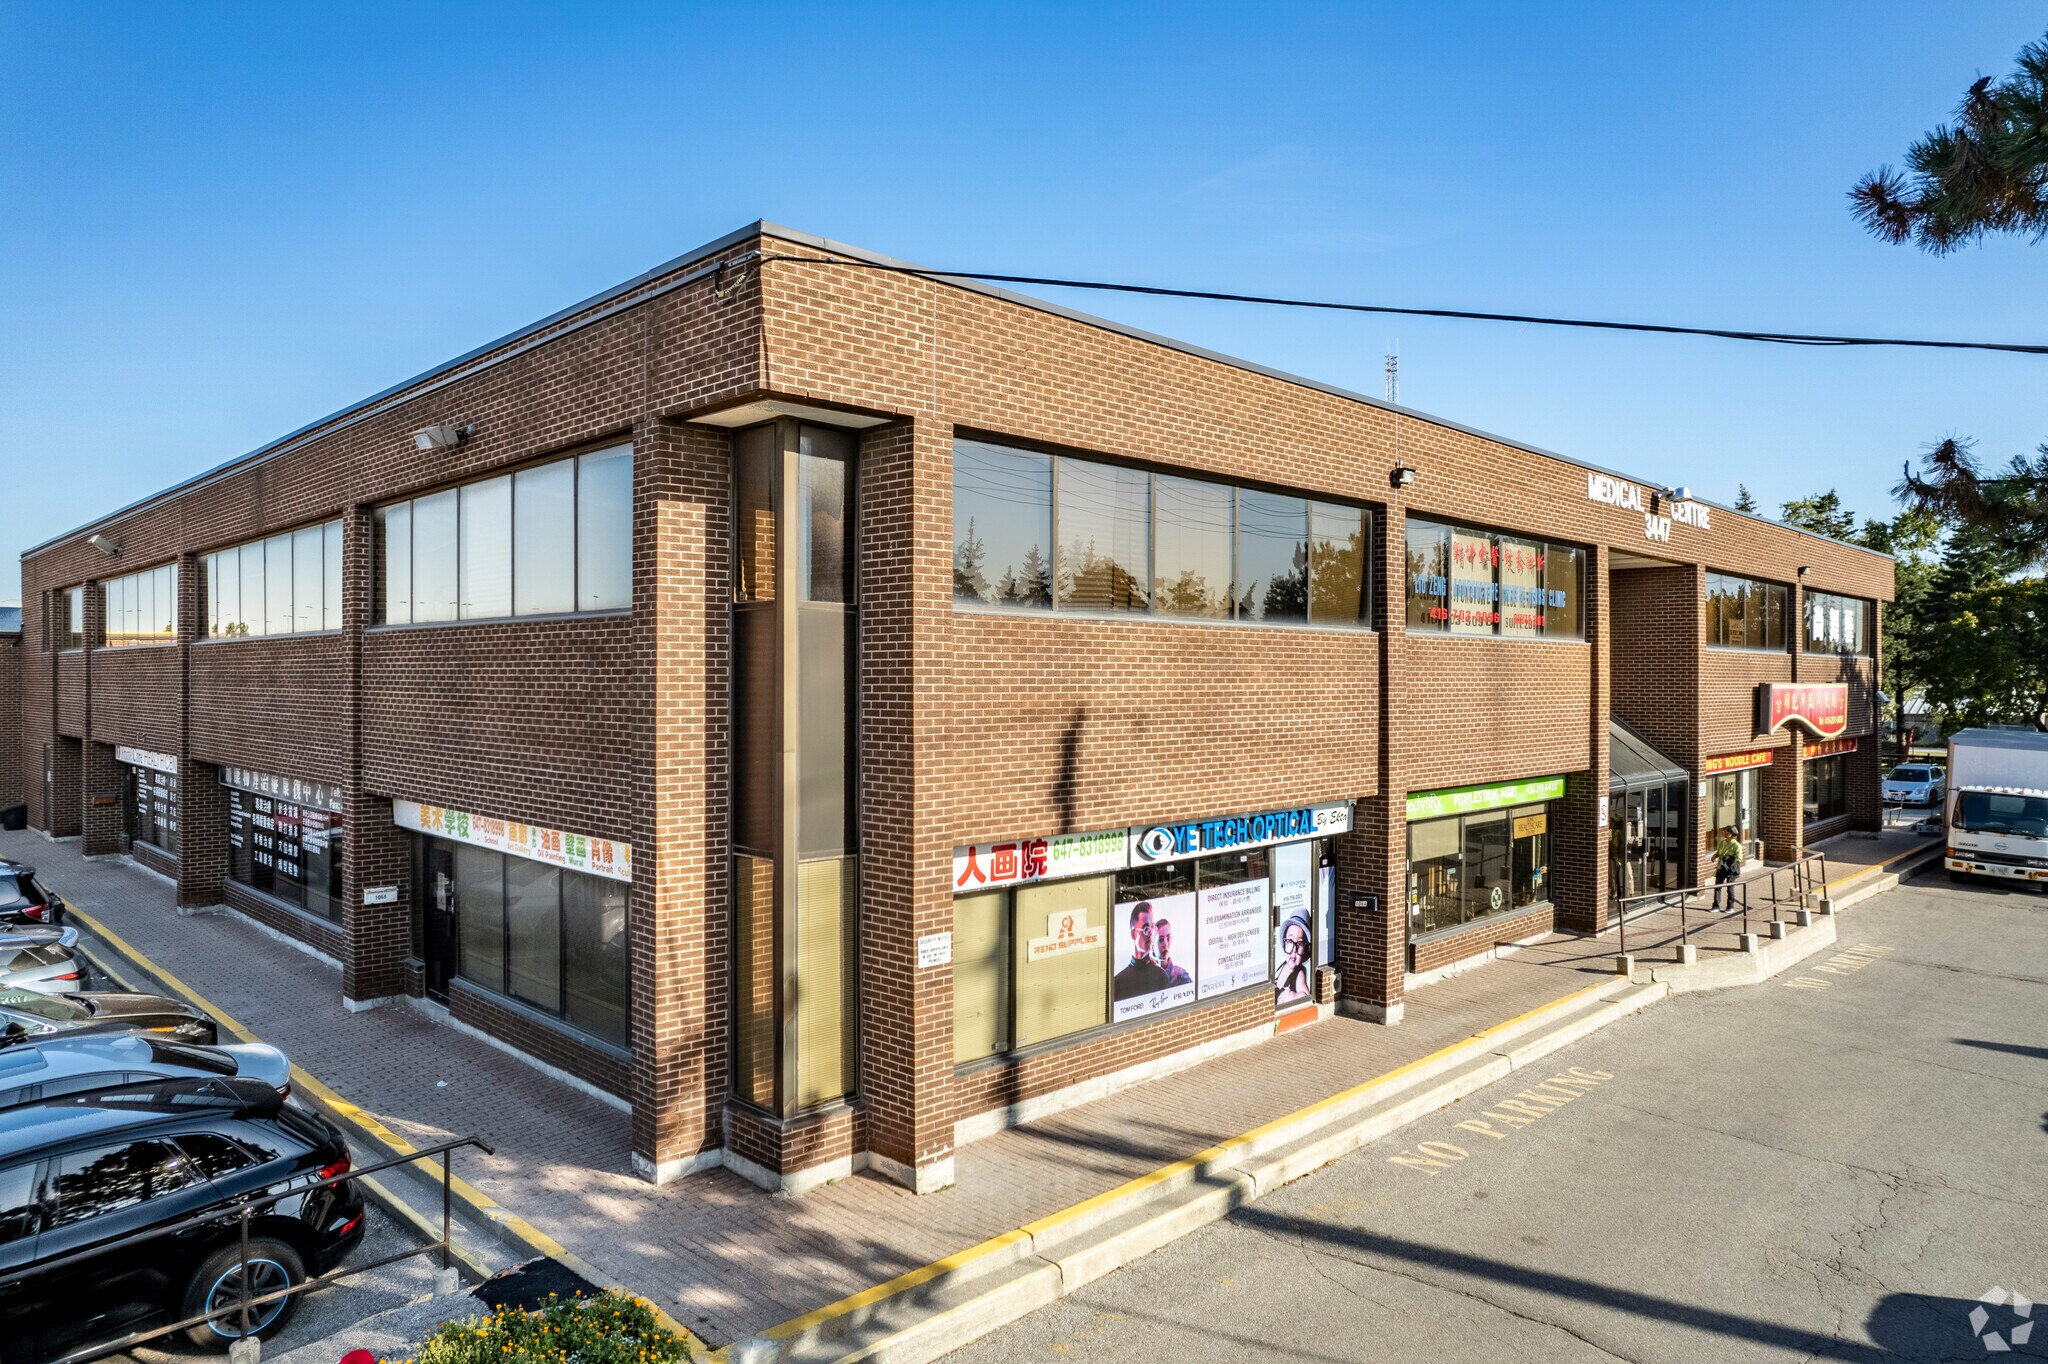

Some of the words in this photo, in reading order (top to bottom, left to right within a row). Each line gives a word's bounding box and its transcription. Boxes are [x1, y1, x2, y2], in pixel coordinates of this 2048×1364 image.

[1587, 472, 1645, 513] MEDICAL
[1670, 500, 1711, 530] CENTRE
[1644, 512, 1671, 543] 3447
[1429, 576, 1447, 596] ZENG
[1725, 754, 1749, 768] NOODLE
[1752, 752, 1767, 764] CAFE
[1202, 818, 1249, 851] TECH
[1252, 809, 1319, 842] OPTICAL
[1053, 831, 1124, 861] 647-8318998
[545, 851, 566, 865] Painting
[591, 861, 614, 874] Portrait
[957, 838, 1048, 887] 人画院
[1207, 893, 1223, 902] DIRECT
[1223, 888, 1245, 899] INSURANCE
[1246, 885, 1261, 895] BILLING
[1206, 916, 1214, 925] EYE
[1214, 910, 1241, 923] EXAMINATION
[1241, 906, 1262, 917] ARRANGED
[1057, 935, 1098, 950] SUPPLIES
[1208, 936, 1224, 946] DIGITAL
[1245, 927, 1260, 937] LENSES
[1217, 953, 1236, 965] CONTACT
[1236, 950, 1252, 960] LENSES
[1173, 989, 1195, 1001] PRADA
[1120, 1004, 1131, 1014] TOM
[1131, 1002, 1144, 1011] FORD
[1385, 1139, 1470, 1177] NO
[1454, 1065, 1615, 1141] PARKING
